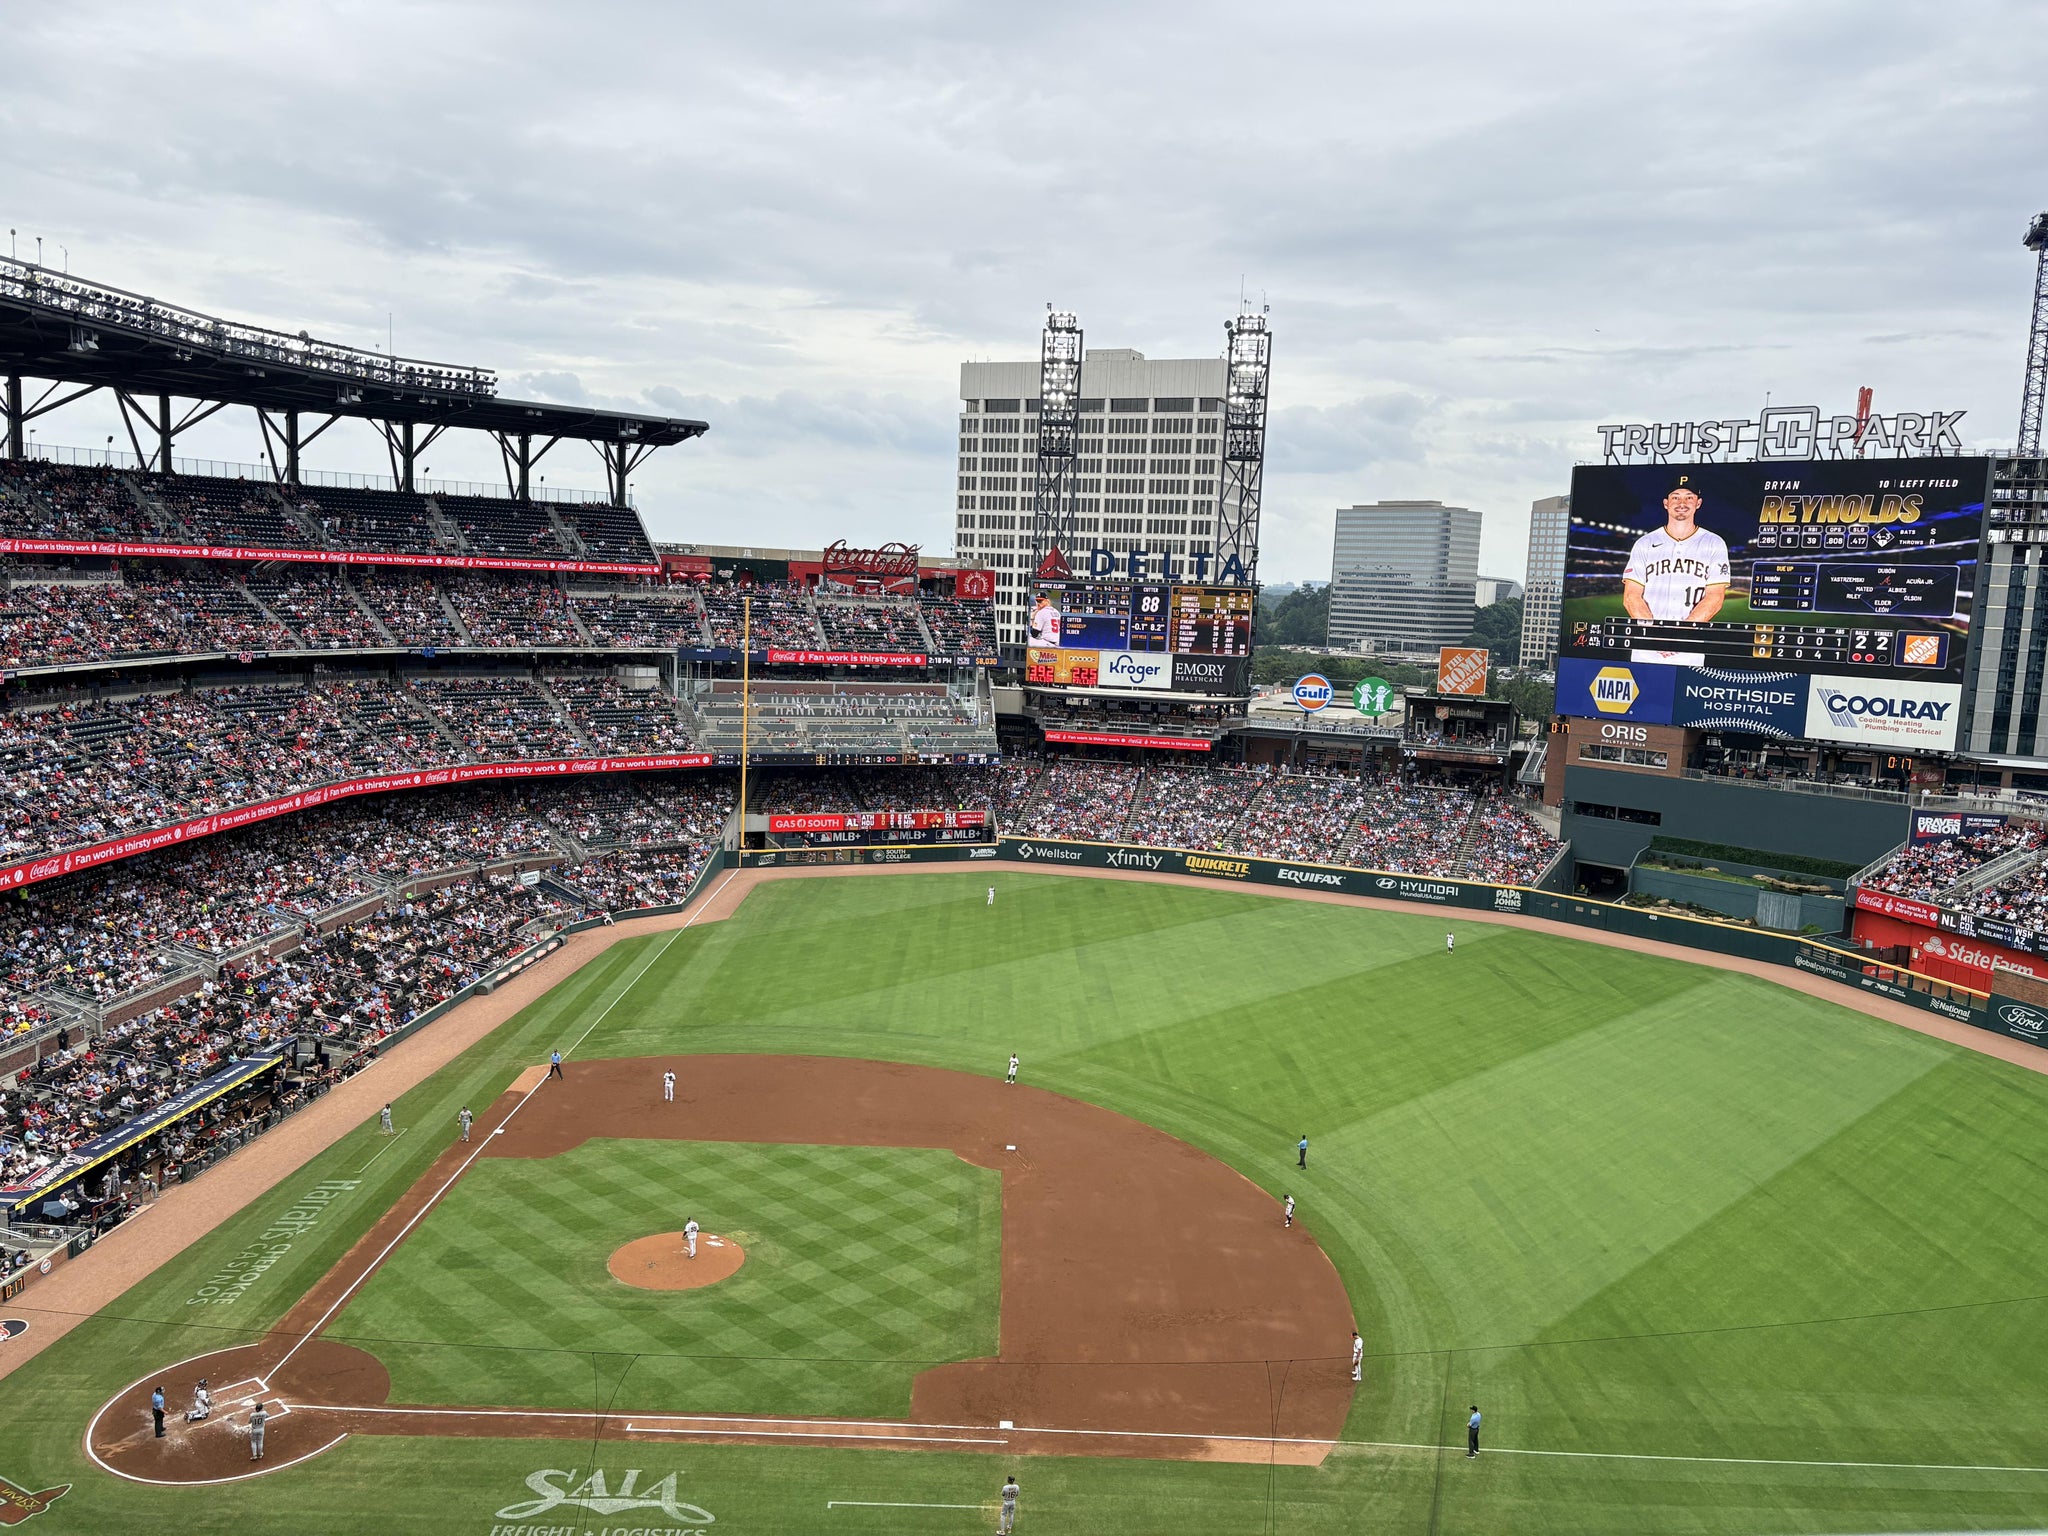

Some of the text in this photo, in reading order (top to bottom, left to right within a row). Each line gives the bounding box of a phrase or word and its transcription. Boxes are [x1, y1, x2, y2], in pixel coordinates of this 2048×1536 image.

[1598, 411, 1968, 456] TRUIST PARK
[1680, 476, 1688, 486] P
[1764, 480, 1958, 490] BRYAN 10 LEFT FIELD
[1760, 494, 1924, 524] REYNOLDS
[282, 552, 302, 560] thirsty
[822, 539, 924, 575] Coca-Cola
[512, 561, 532, 570] thirsty
[1090, 548, 1248, 582] DELTA
[1646, 558, 1710, 583] PIRATES
[1141, 596, 1160, 612] 88
[1760, 634, 1766, 642] 2
[1779, 635, 1784, 644] 2
[1797, 636, 1804, 644] 0
[1816, 638, 1822, 646] 0
[1855, 636, 1888, 650] 2 2
[1759, 648, 1766, 656] 0
[1777, 648, 1783, 657] 2
[1796, 650, 1802, 658] 0
[1814, 650, 1821, 659] 4
[1904, 636, 1940, 663] HOME
[860, 655, 888, 664] thirsty
[1445, 653, 1464, 671] THE
[1030, 666, 1054, 678] 392
[1072, 668, 1098, 680] 225
[1110, 654, 1160, 684] Kroger
[1176, 662, 1226, 677] EMORY
[1438, 648, 1488, 694] HOME
[1176, 676, 1223, 684] HEALTHCARE
[1456, 668, 1487, 694] DEPOT
[1295, 686, 1330, 700] Gulf
[1598, 677, 1632, 702] NAPA
[1686, 684, 1795, 706] NORTHSIDE
[770, 696, 952, 717] HANK AARON TERRACE
[1704, 700, 1772, 716] HOSPITAL
[1826, 694, 1952, 721] COOLRAY
[1551, 722, 1570, 734] 0:17
[1858, 716, 1923, 728] Cooling Heating
[1602, 724, 1647, 742] ORIS
[1864, 724, 1942, 736] Plumbing Electrical
[626, 759, 646, 768] work
[655, 757, 680, 766] thirsty
[682, 756, 700, 764] work
[1888, 756, 1912, 770] 0:17
[474, 768, 494, 776] work
[505, 766, 532, 776] thirsty
[534, 764, 556, 772] work
[776, 818, 840, 828] GAS SOUTH
[846, 818, 858, 826] AL
[1918, 817, 1961, 826] BRAVES
[832, 832, 862, 841] MLB+
[900, 830, 927, 840] MLB+
[954, 830, 981, 839] MLB+
[1918, 824, 1960, 835] VISION
[75, 853, 91, 866] Fan
[93, 848, 114, 861] work
[124, 838, 152, 852] thirsty
[152, 832, 172, 845] work
[1036, 848, 1082, 860] Wellstar
[1106, 848, 1163, 870] xfinity
[1186, 856, 1250, 874] QUIKRETE
[1278, 868, 1343, 886] EQUIFAX
[1400, 881, 1458, 896] HYUNDAI
[1496, 889, 1522, 900] PAPA
[1494, 898, 1522, 907] JOHNS
[1858, 894, 1884, 908] Coca-Cola
[1894, 907, 1914, 916] thirsty
[1942, 914, 1956, 928] NL
[1960, 914, 2034, 939] MIL WSH
[1960, 922, 2026, 946] COL AZ
[1794, 954, 1847, 979] globalpayments
[1948, 942, 2034, 976] State Farm
[1938, 1002, 1970, 1018] National
[2008, 1008, 2044, 1032] Ford
[260, 1180, 362, 1242] Harrah's
[186, 1243, 268, 1304] CASINOS
[218, 1243, 292, 1304] CHEROKEE
[5, 1278, 24, 1299] 0:17
[500, 1468, 704, 1512] SAIA
[490, 1524, 707, 1536] FREIGHT LOGISTICS
